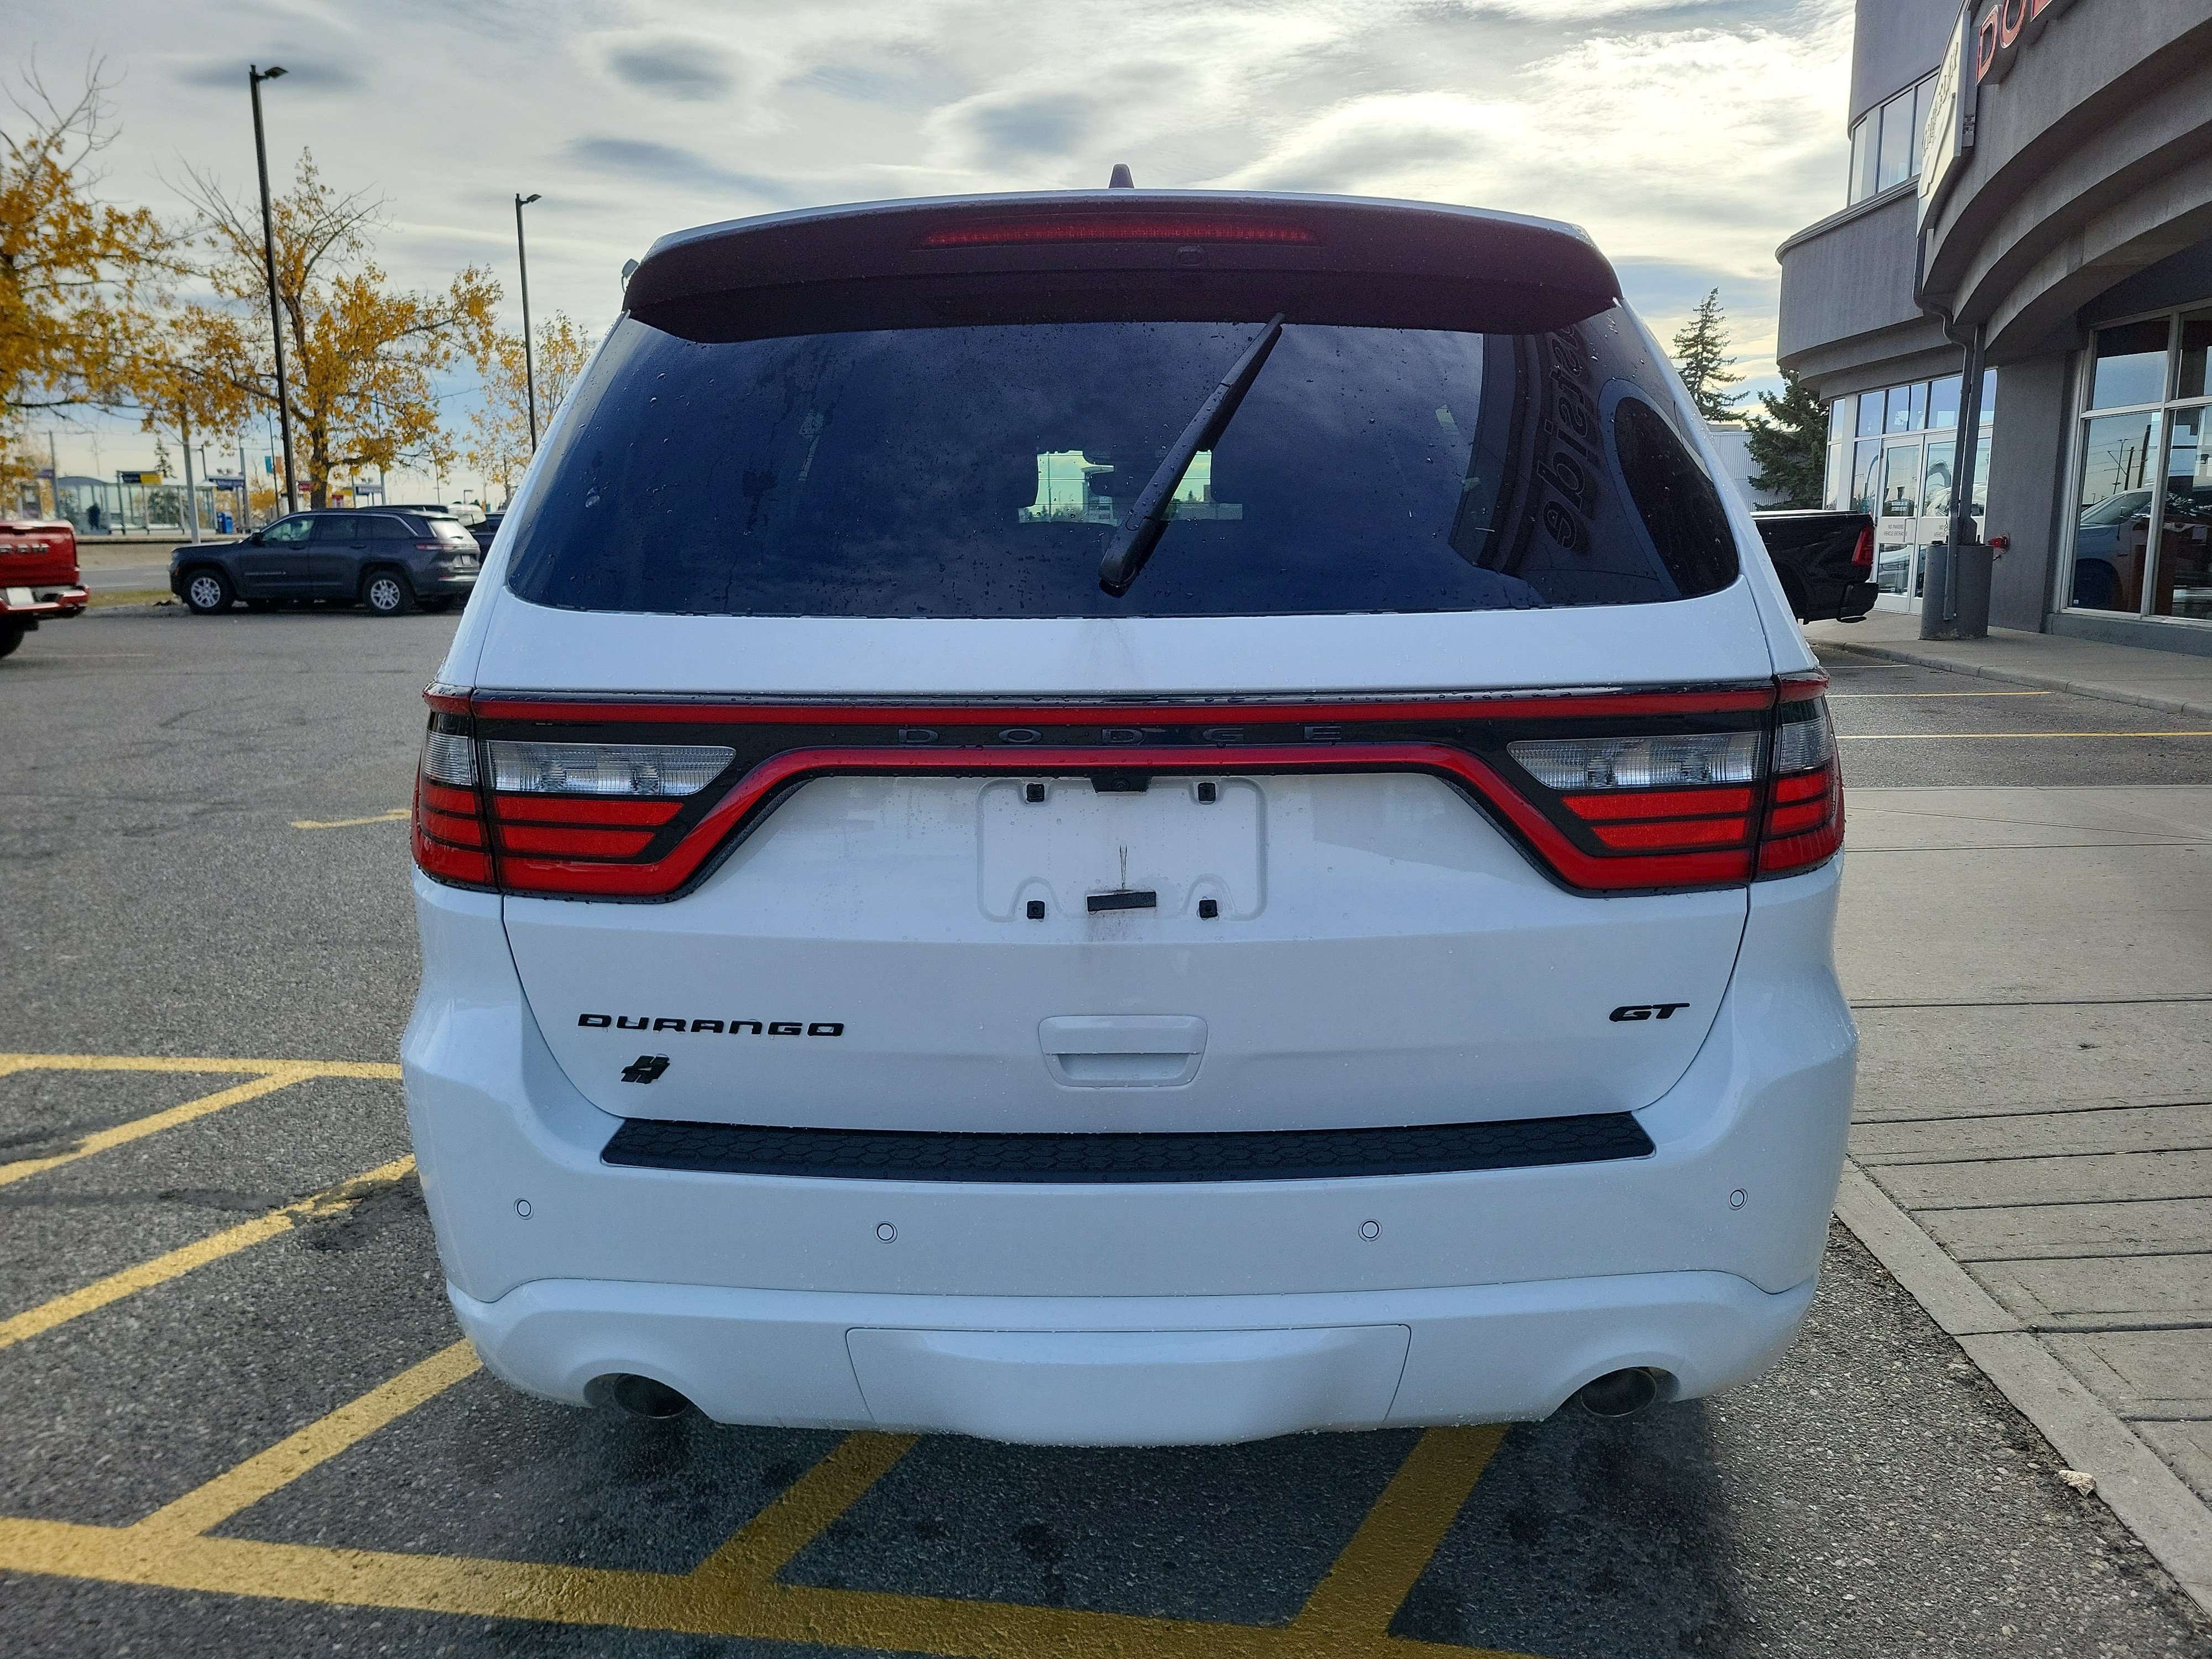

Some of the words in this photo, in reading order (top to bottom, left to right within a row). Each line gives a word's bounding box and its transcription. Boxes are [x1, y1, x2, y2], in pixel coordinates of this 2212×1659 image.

[1975, 0, 2052, 87] DO
[898, 726, 1341, 744] DODGE
[1609, 1003, 1691, 1022] GT
[577, 1014, 844, 1036] DURANGO
